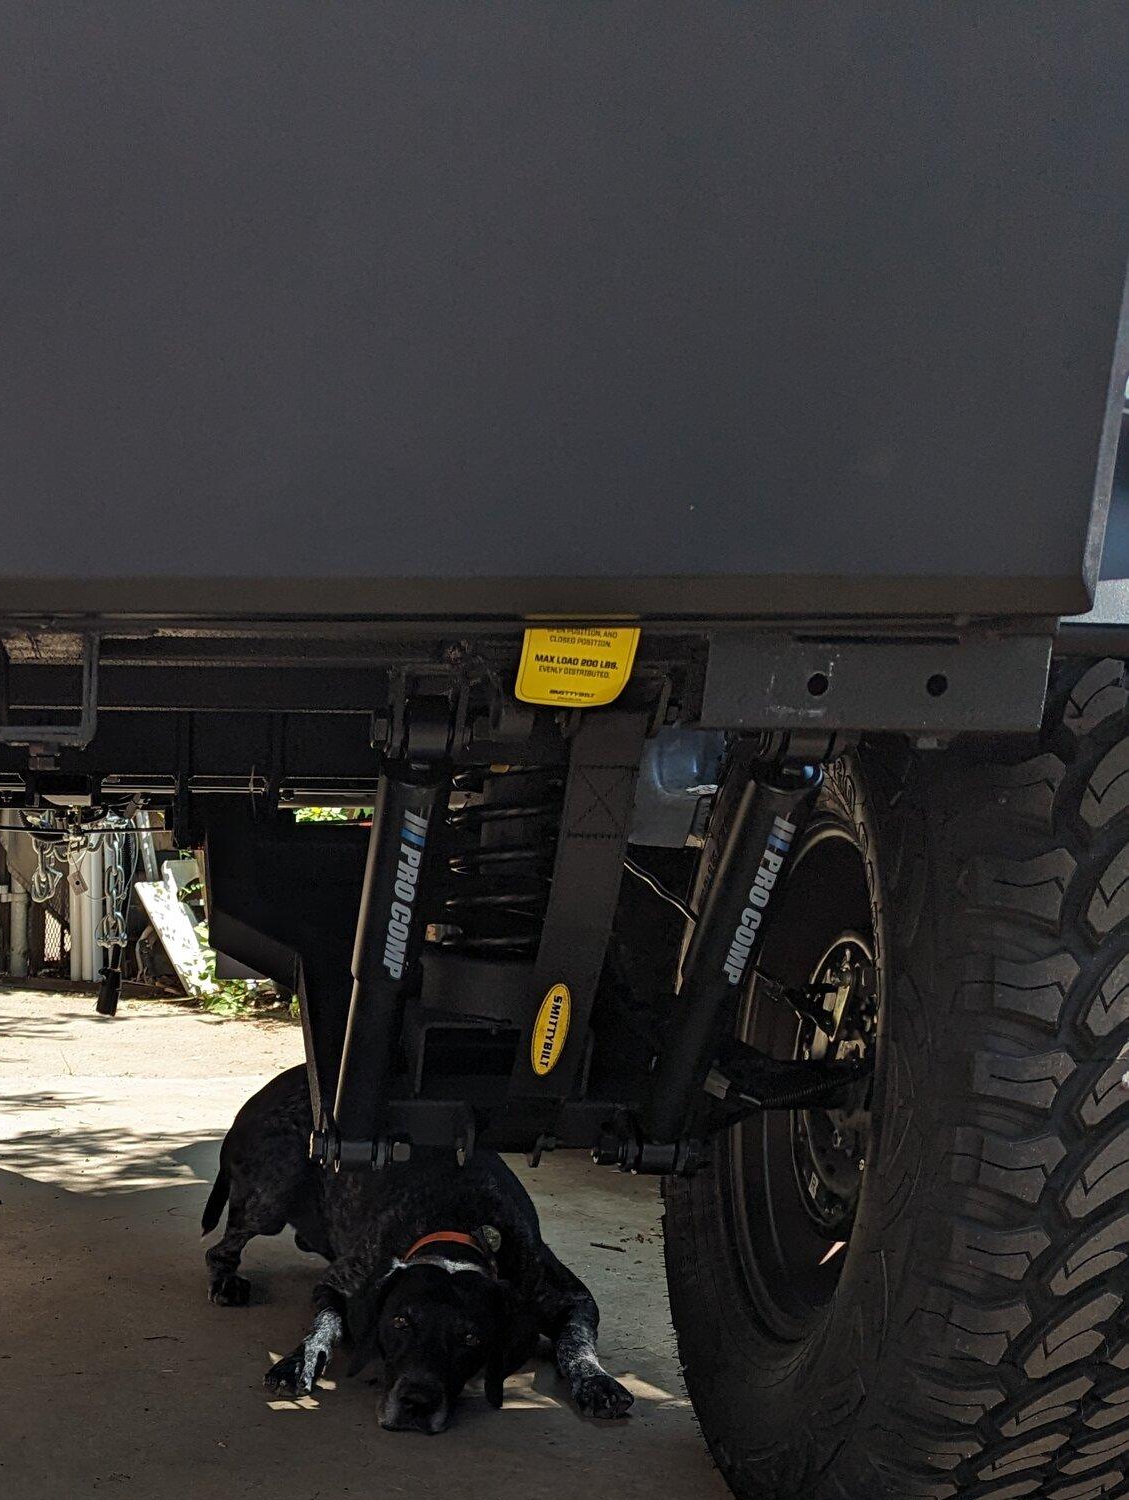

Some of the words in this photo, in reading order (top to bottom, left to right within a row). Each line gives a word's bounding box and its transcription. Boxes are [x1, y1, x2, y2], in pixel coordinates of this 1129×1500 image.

[535, 654, 555, 664] MAX
[556, 656, 579, 666] LOAD
[580, 658, 599, 668] 200
[600, 660, 619, 670] LBS.
[550, 635, 575, 645] CLOSED
[603, 631, 618, 639] AND
[538, 665, 563, 674] EVENLY
[394, 842, 422, 902] PRO
[748, 849, 786, 907] PRO
[383, 901, 413, 980] COMP
[723, 907, 762, 986] COMP
[539, 994, 563, 1069] SMITTYBILT
